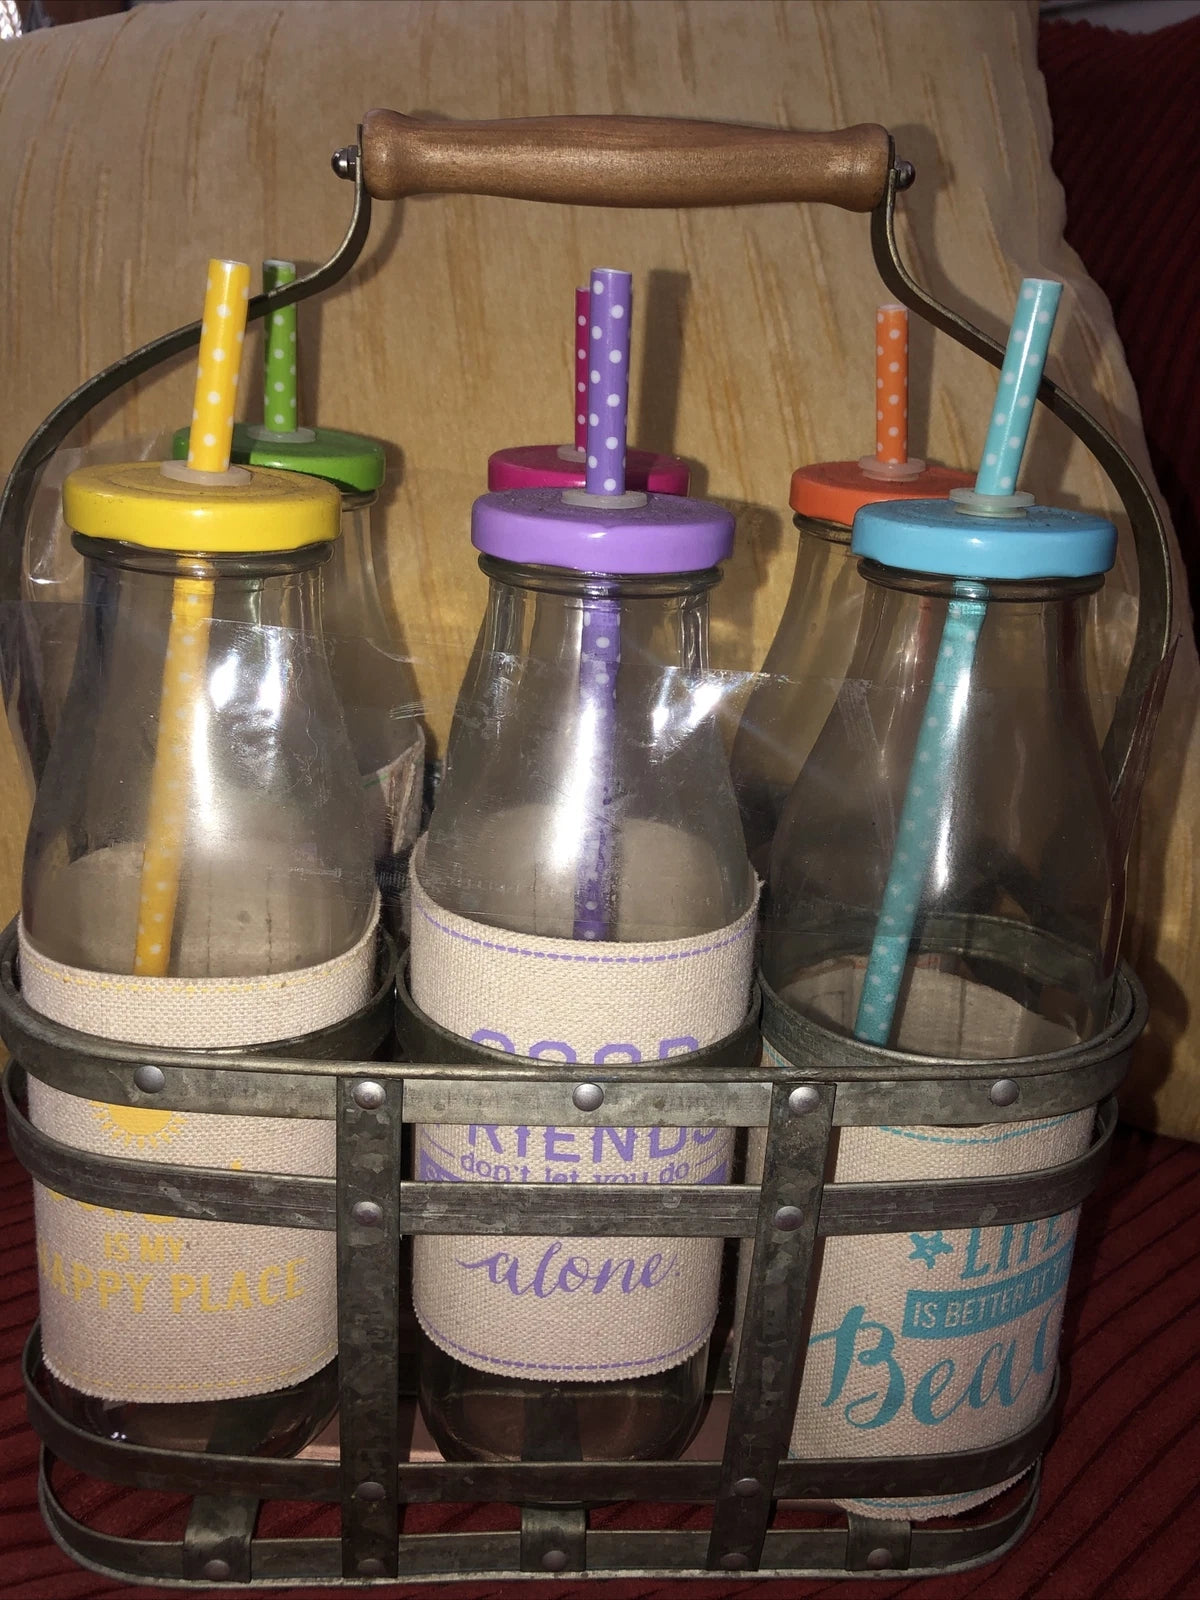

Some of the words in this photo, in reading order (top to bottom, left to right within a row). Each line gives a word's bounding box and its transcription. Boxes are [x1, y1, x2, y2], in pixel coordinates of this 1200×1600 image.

[659, 1161, 691, 1184] do
[103, 1231, 131, 1263] IS
[139, 1233, 184, 1264] MY
[170, 1257, 307, 1314] PLACE
[912, 1301, 939, 1329] IS
[943, 1283, 1025, 1329] BETTER
